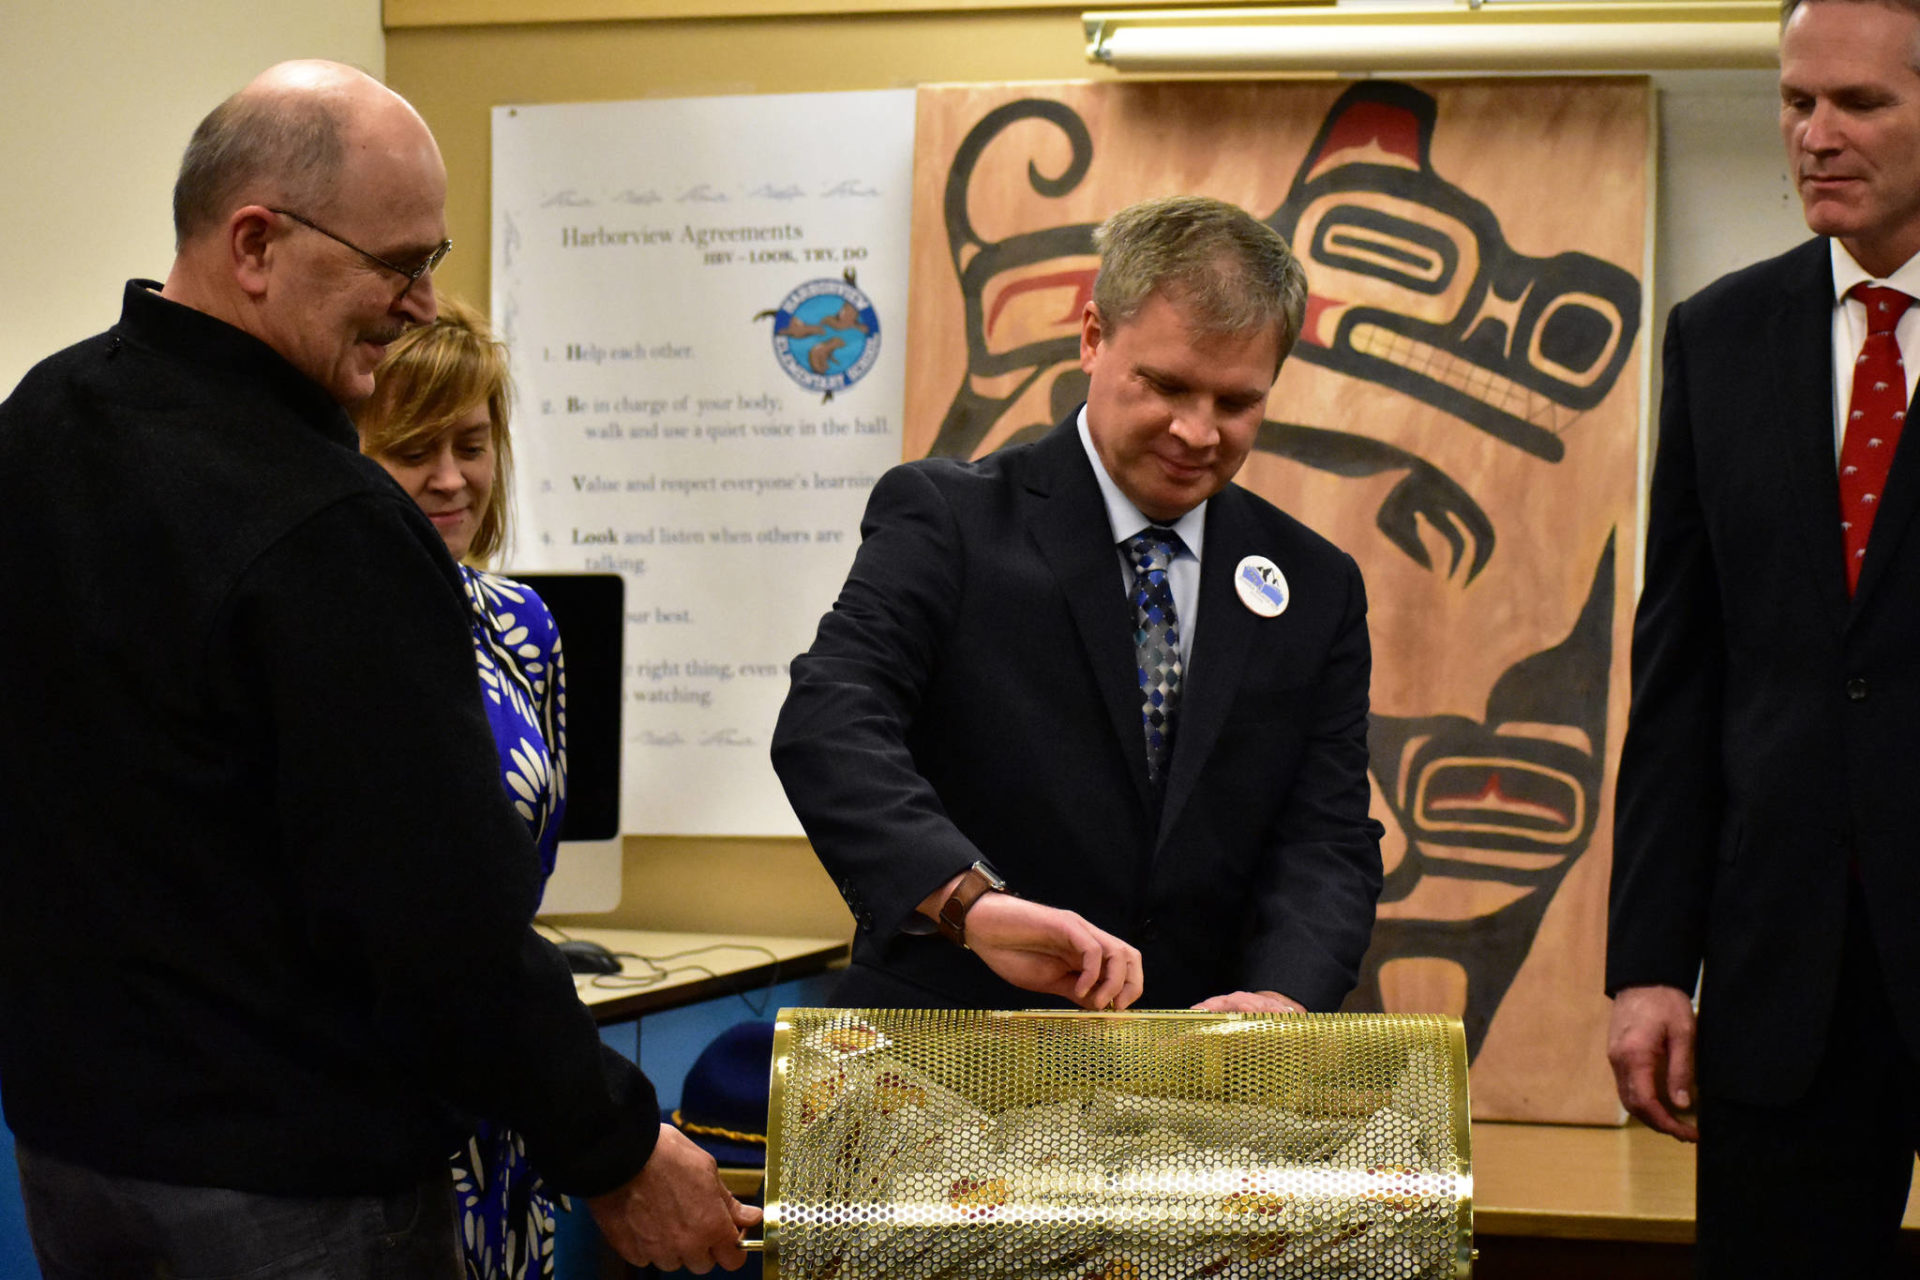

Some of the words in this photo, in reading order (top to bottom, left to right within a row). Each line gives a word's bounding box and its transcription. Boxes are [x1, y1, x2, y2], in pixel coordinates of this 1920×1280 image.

[561, 226, 673, 248] Harborview
[681, 222, 803, 249] Agreements
[842, 247, 868, 260] DO
[567, 344, 606, 366] Help
[609, 344, 647, 360] each
[567, 397, 585, 412] Be
[613, 396, 667, 416] charge
[672, 395, 689, 410] of
[697, 398, 731, 416] your
[585, 422, 622, 438] walk
[630, 422, 658, 438] and
[706, 422, 747, 442] quiet
[751, 421, 794, 437] voice
[800, 419, 816, 435] in
[821, 418, 848, 435] the
[572, 475, 619, 492] Value
[626, 473, 655, 490] and
[660, 477, 716, 496] respect
[572, 527, 618, 544] Look
[624, 527, 654, 543] and
[660, 526, 704, 543] listen
[709, 526, 752, 543] when
[757, 525, 810, 543] others
[817, 530, 842, 542] are
[637, 660, 679, 680] right
[740, 664, 777, 676] even
